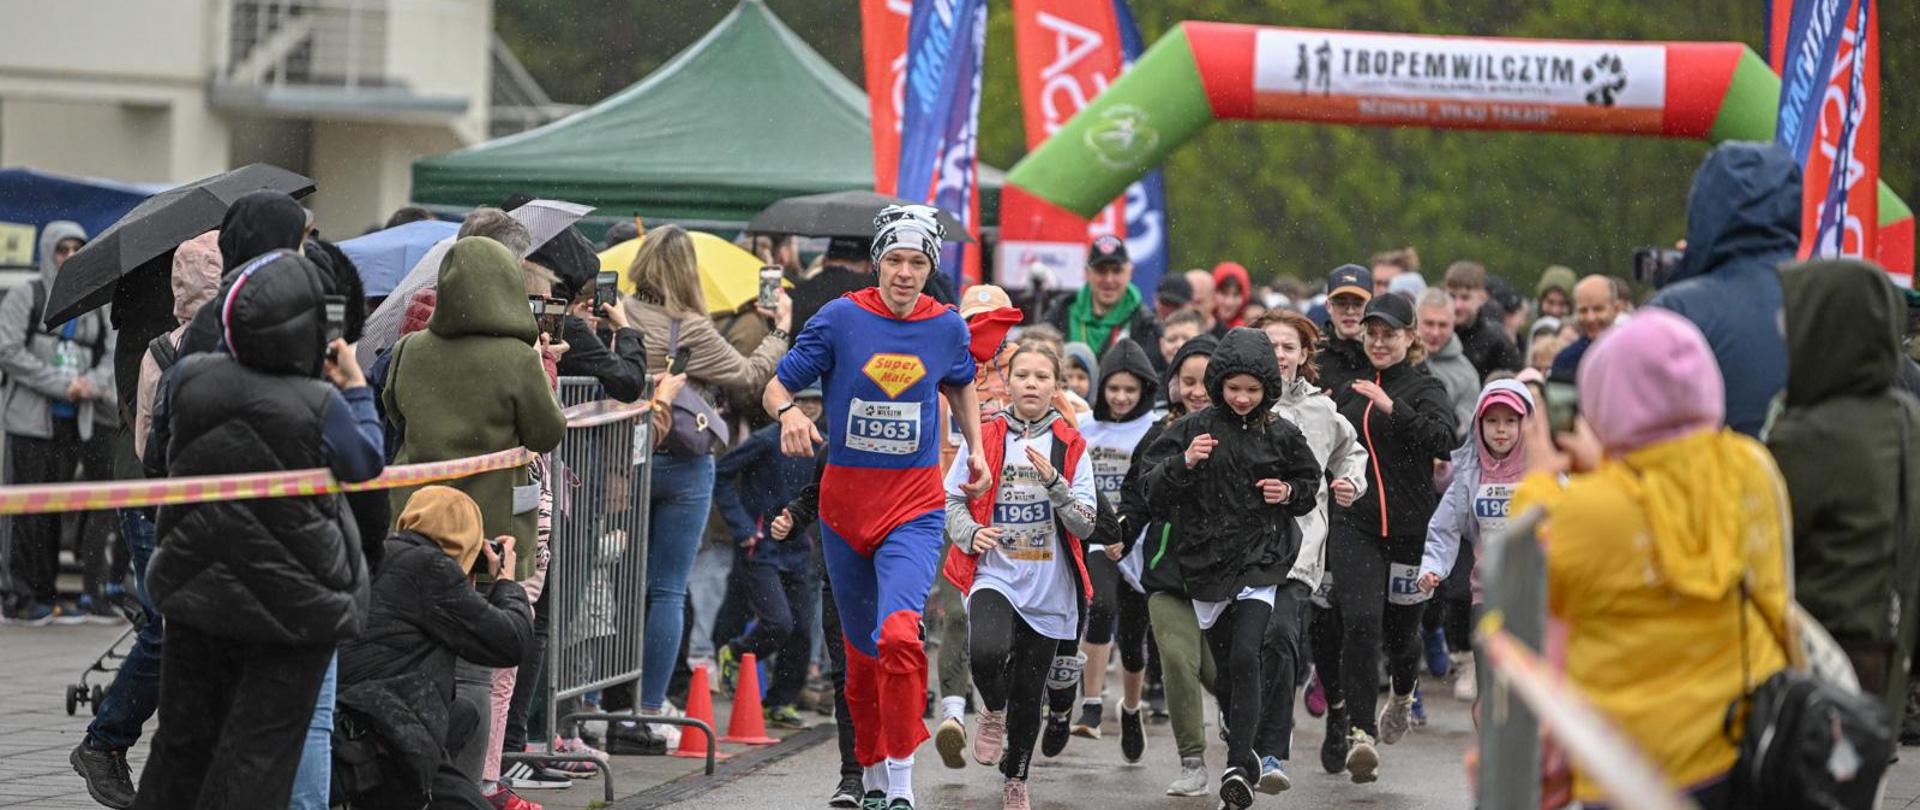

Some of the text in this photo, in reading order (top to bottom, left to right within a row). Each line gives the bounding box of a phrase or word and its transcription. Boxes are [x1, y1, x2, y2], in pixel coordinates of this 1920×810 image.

[875, 357, 917, 371] Super
[881, 371, 913, 384] Male
[857, 419, 910, 440] 1963
[1095, 475, 1125, 491] 963
[998, 504, 1045, 523] 1963
[1480, 500, 1511, 516] 196
[1398, 579, 1418, 593] 19
